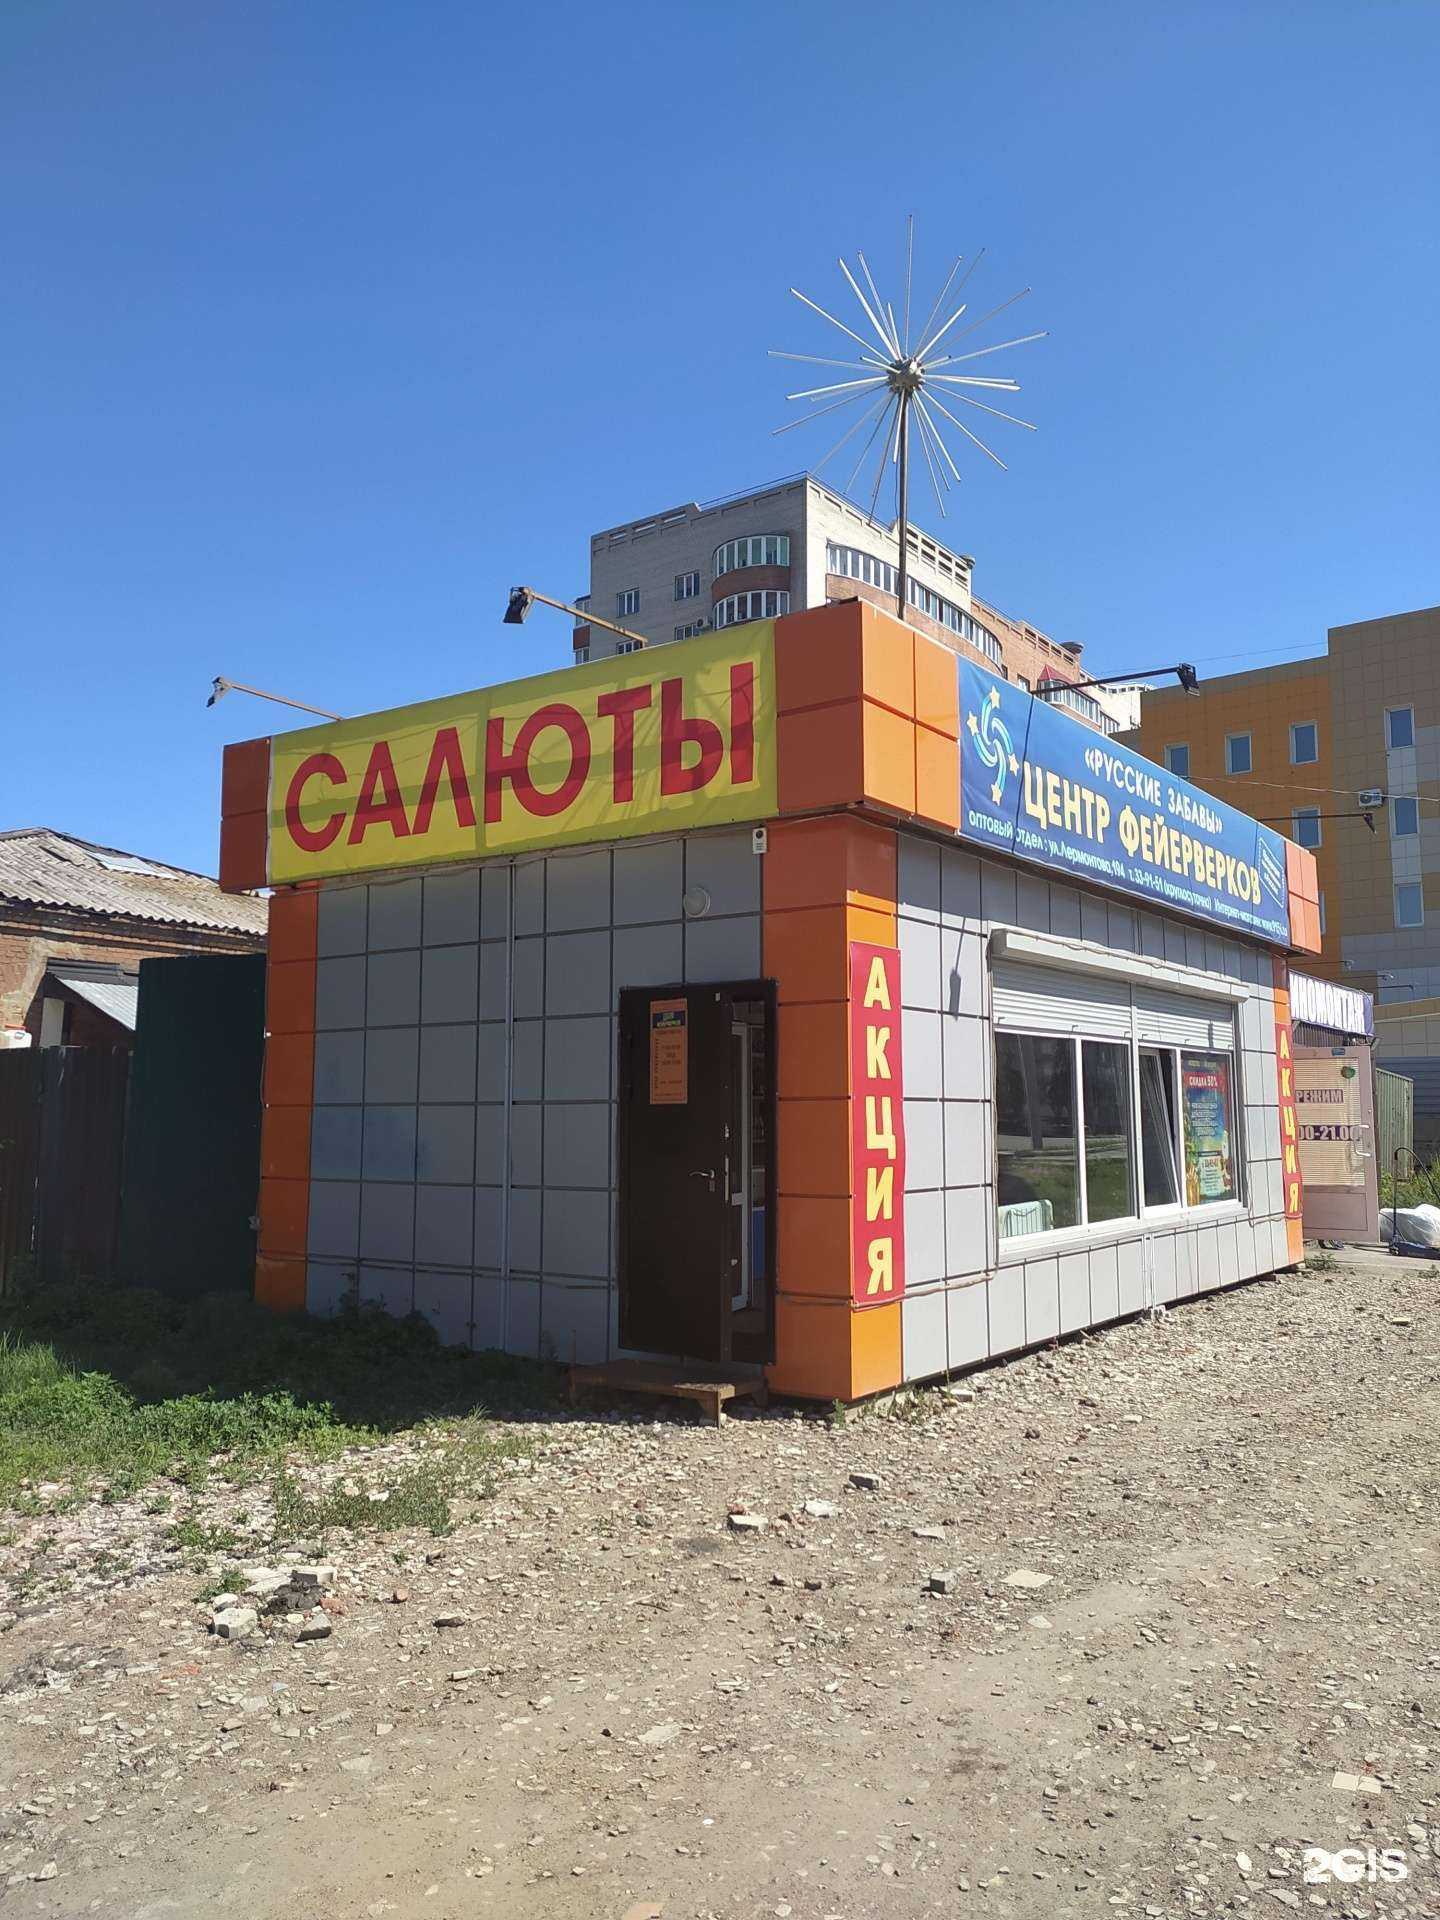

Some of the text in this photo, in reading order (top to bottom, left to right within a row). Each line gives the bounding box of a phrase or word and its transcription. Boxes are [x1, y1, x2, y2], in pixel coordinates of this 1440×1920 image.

[285, 661, 754, 852] САЛЮТЫ
[1085, 747, 1223, 834] «РУССКИЕ ЗАБАВЫ»
[1023, 761, 1111, 843] ЦЕНТР
[1118, 805, 1262, 905] ФЕЙЕРВЕРКОВ
[1288, 973, 1365, 1034] ИНОМОНТАЖ
[863, 956, 897, 1295] АКЦИЯ
[1279, 1030, 1299, 1213] АКЦИЯ
[1296, 1089, 1343, 1104] РЕЖИМ
[1298, 1125, 1360, 1141] 00-21.00
